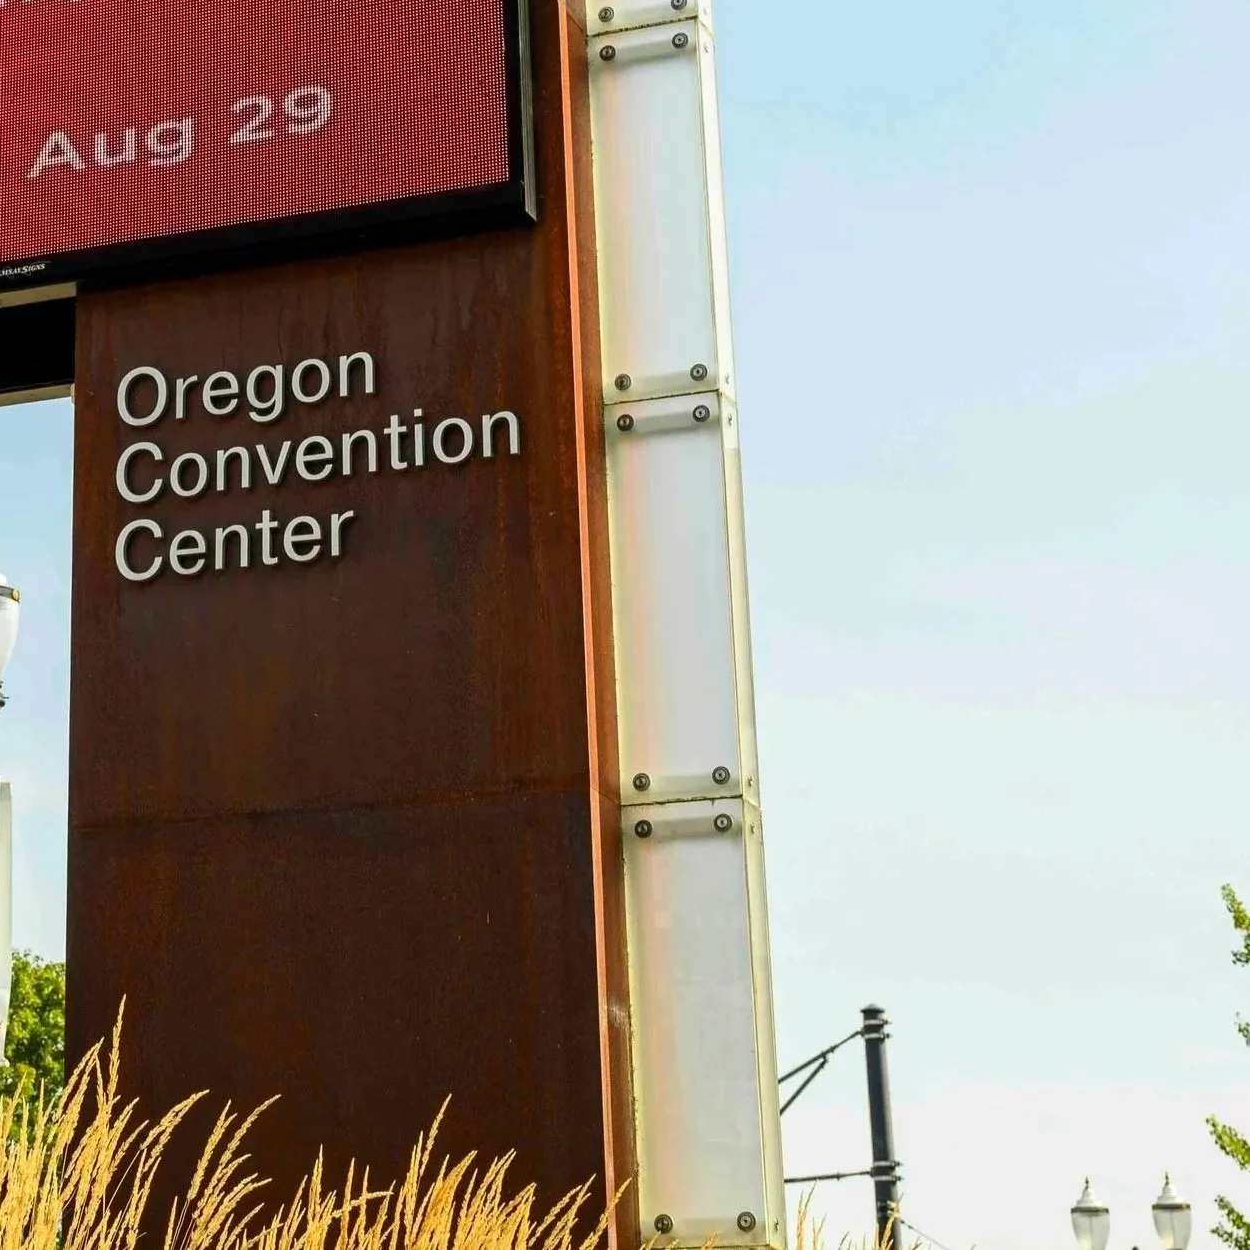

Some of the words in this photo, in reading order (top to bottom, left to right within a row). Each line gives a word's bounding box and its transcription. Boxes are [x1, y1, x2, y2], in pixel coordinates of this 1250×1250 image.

[28, 114, 196, 179] Aug
[230, 85, 333, 145] 29
[117, 351, 377, 427] Oregon
[115, 408, 521, 503] Convention
[115, 509, 355, 581] Center
